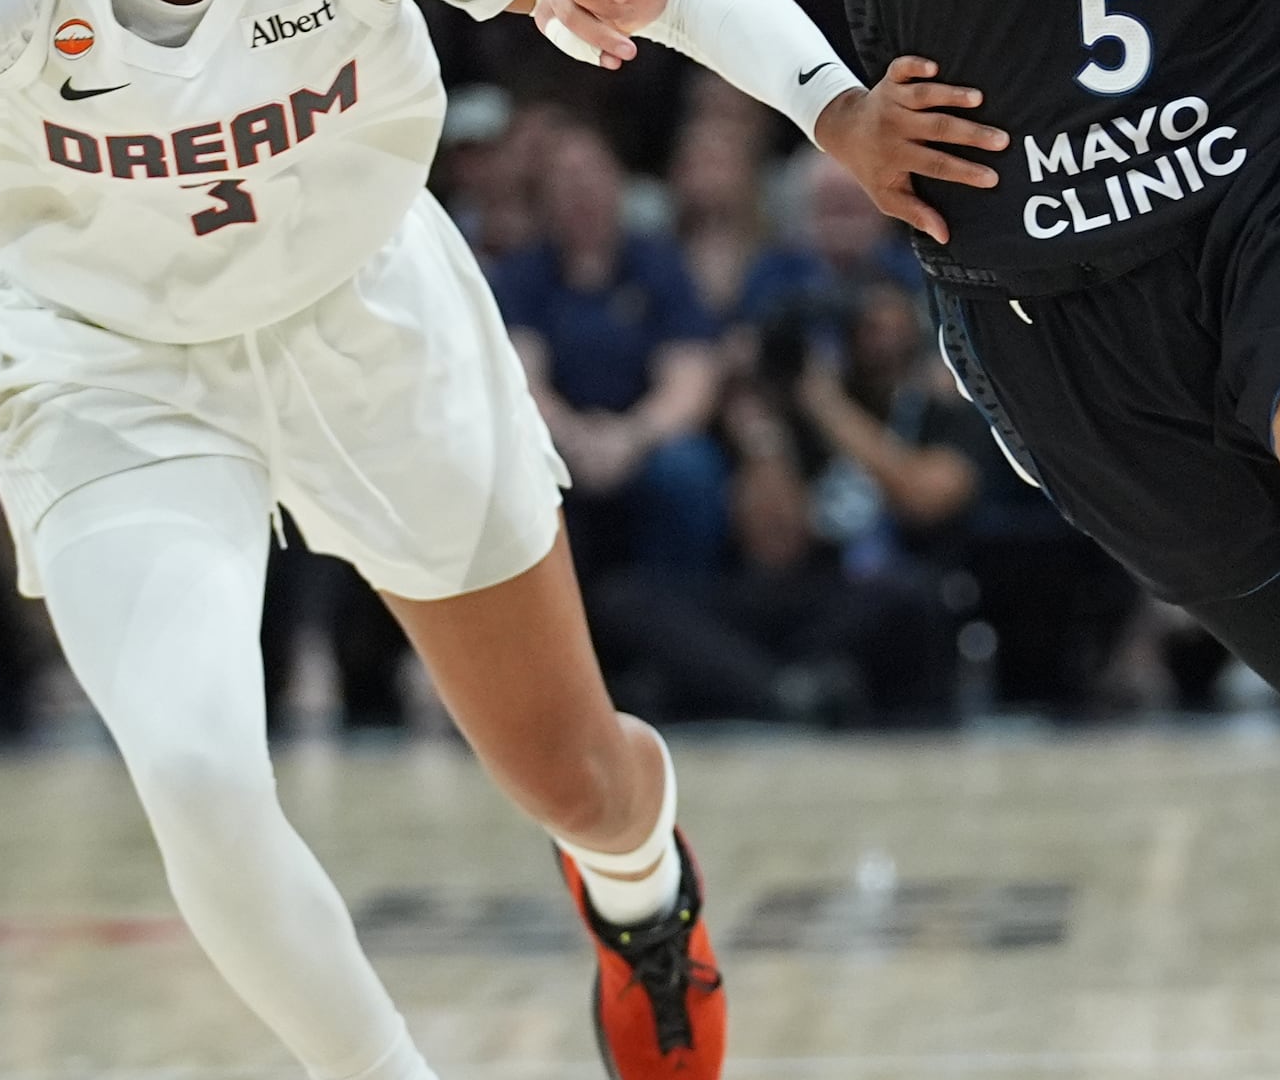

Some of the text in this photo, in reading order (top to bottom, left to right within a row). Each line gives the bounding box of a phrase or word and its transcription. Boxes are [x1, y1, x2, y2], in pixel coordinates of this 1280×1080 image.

[250, 0, 336, 49] Albert
[42, 58, 358, 179] DREAM
[1024, 95, 1210, 183] MAYO
[180, 177, 258, 237] 3
[1023, 125, 1248, 240] CLINIC
